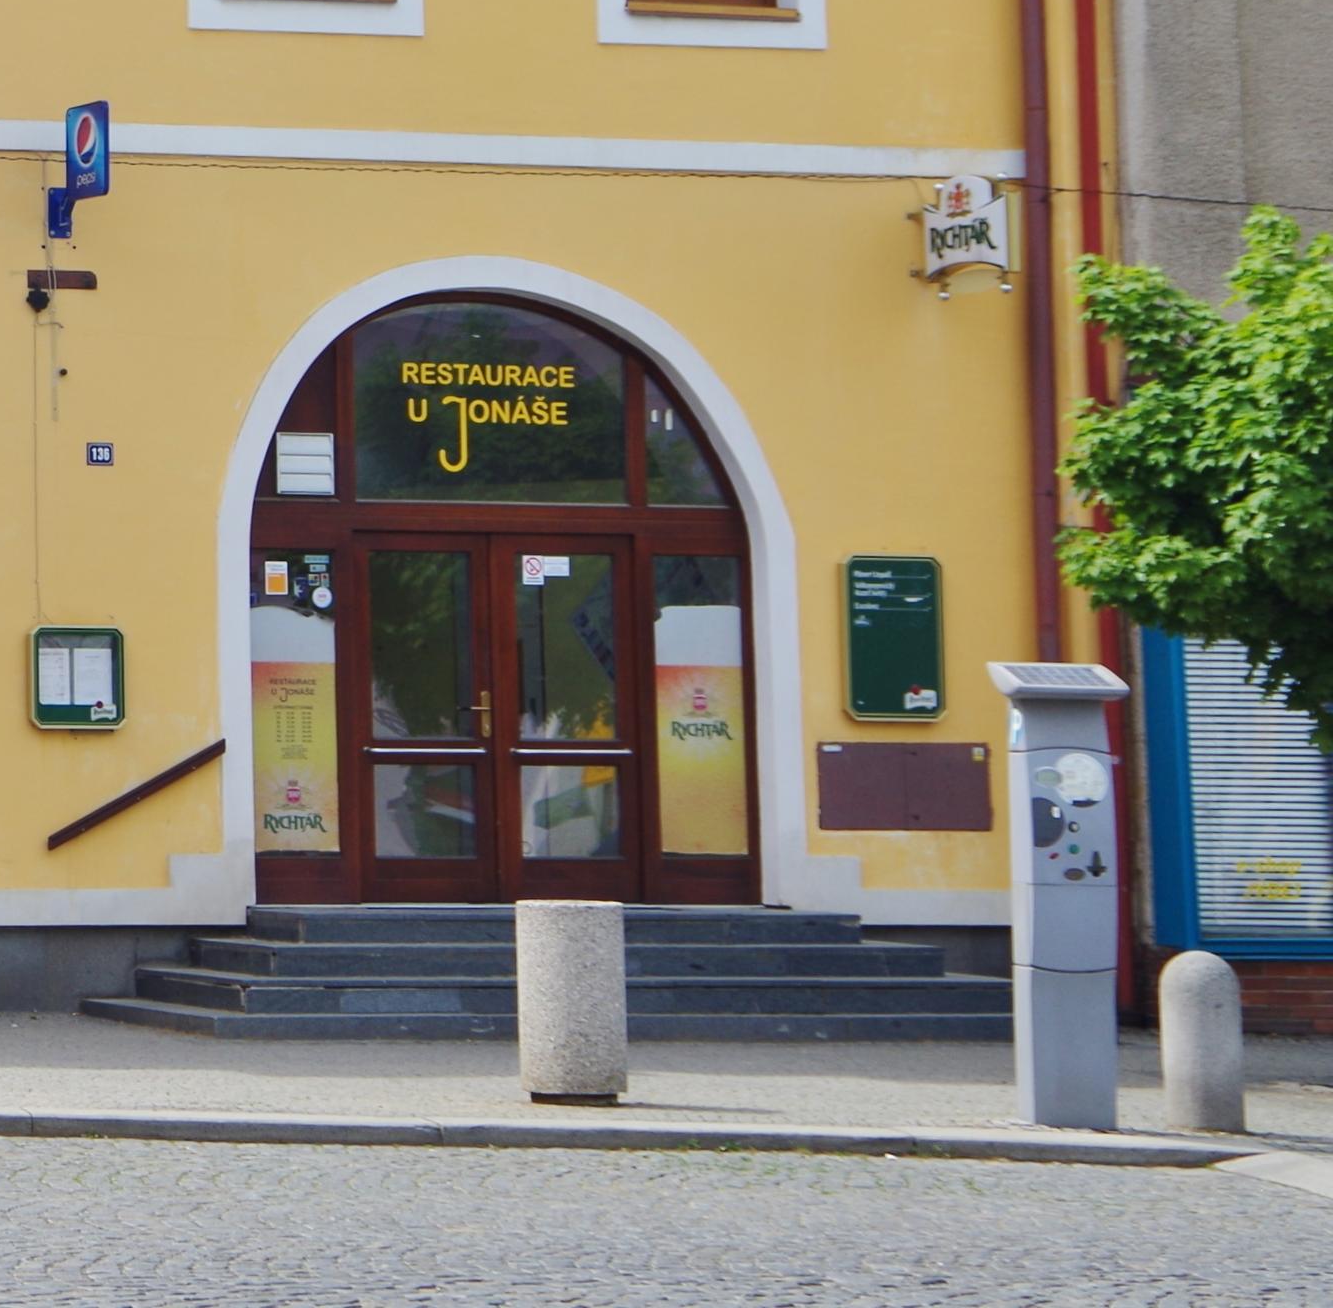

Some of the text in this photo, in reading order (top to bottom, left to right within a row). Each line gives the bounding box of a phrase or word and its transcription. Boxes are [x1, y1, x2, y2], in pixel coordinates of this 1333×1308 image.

[402, 362, 575, 388] RESTAURACE
[408, 395, 568, 473] U JONÁŠE
[91, 447, 110, 461] 136
